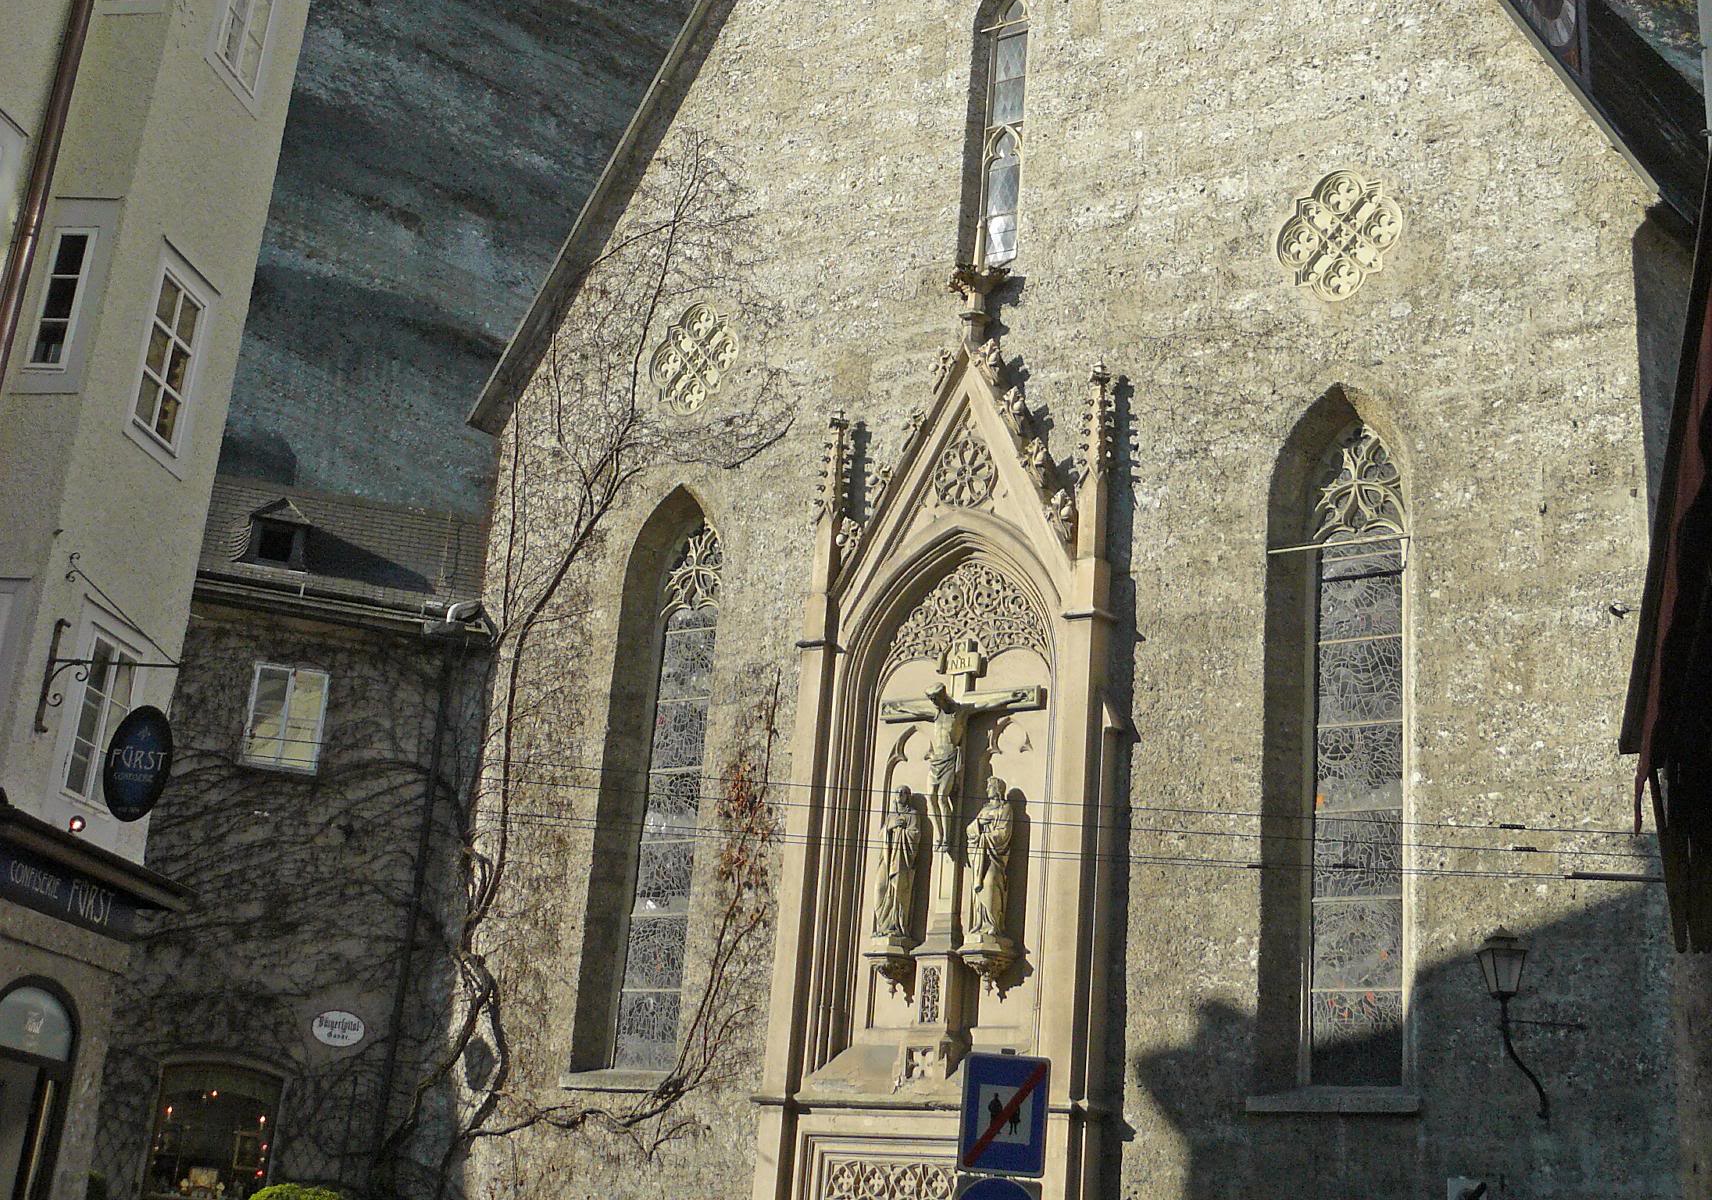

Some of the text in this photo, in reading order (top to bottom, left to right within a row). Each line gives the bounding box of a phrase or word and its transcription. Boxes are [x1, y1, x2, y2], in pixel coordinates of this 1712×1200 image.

[110, 745, 168, 771] FÜRST
[10, 859, 116, 926] CONFISERIE FÜRST
